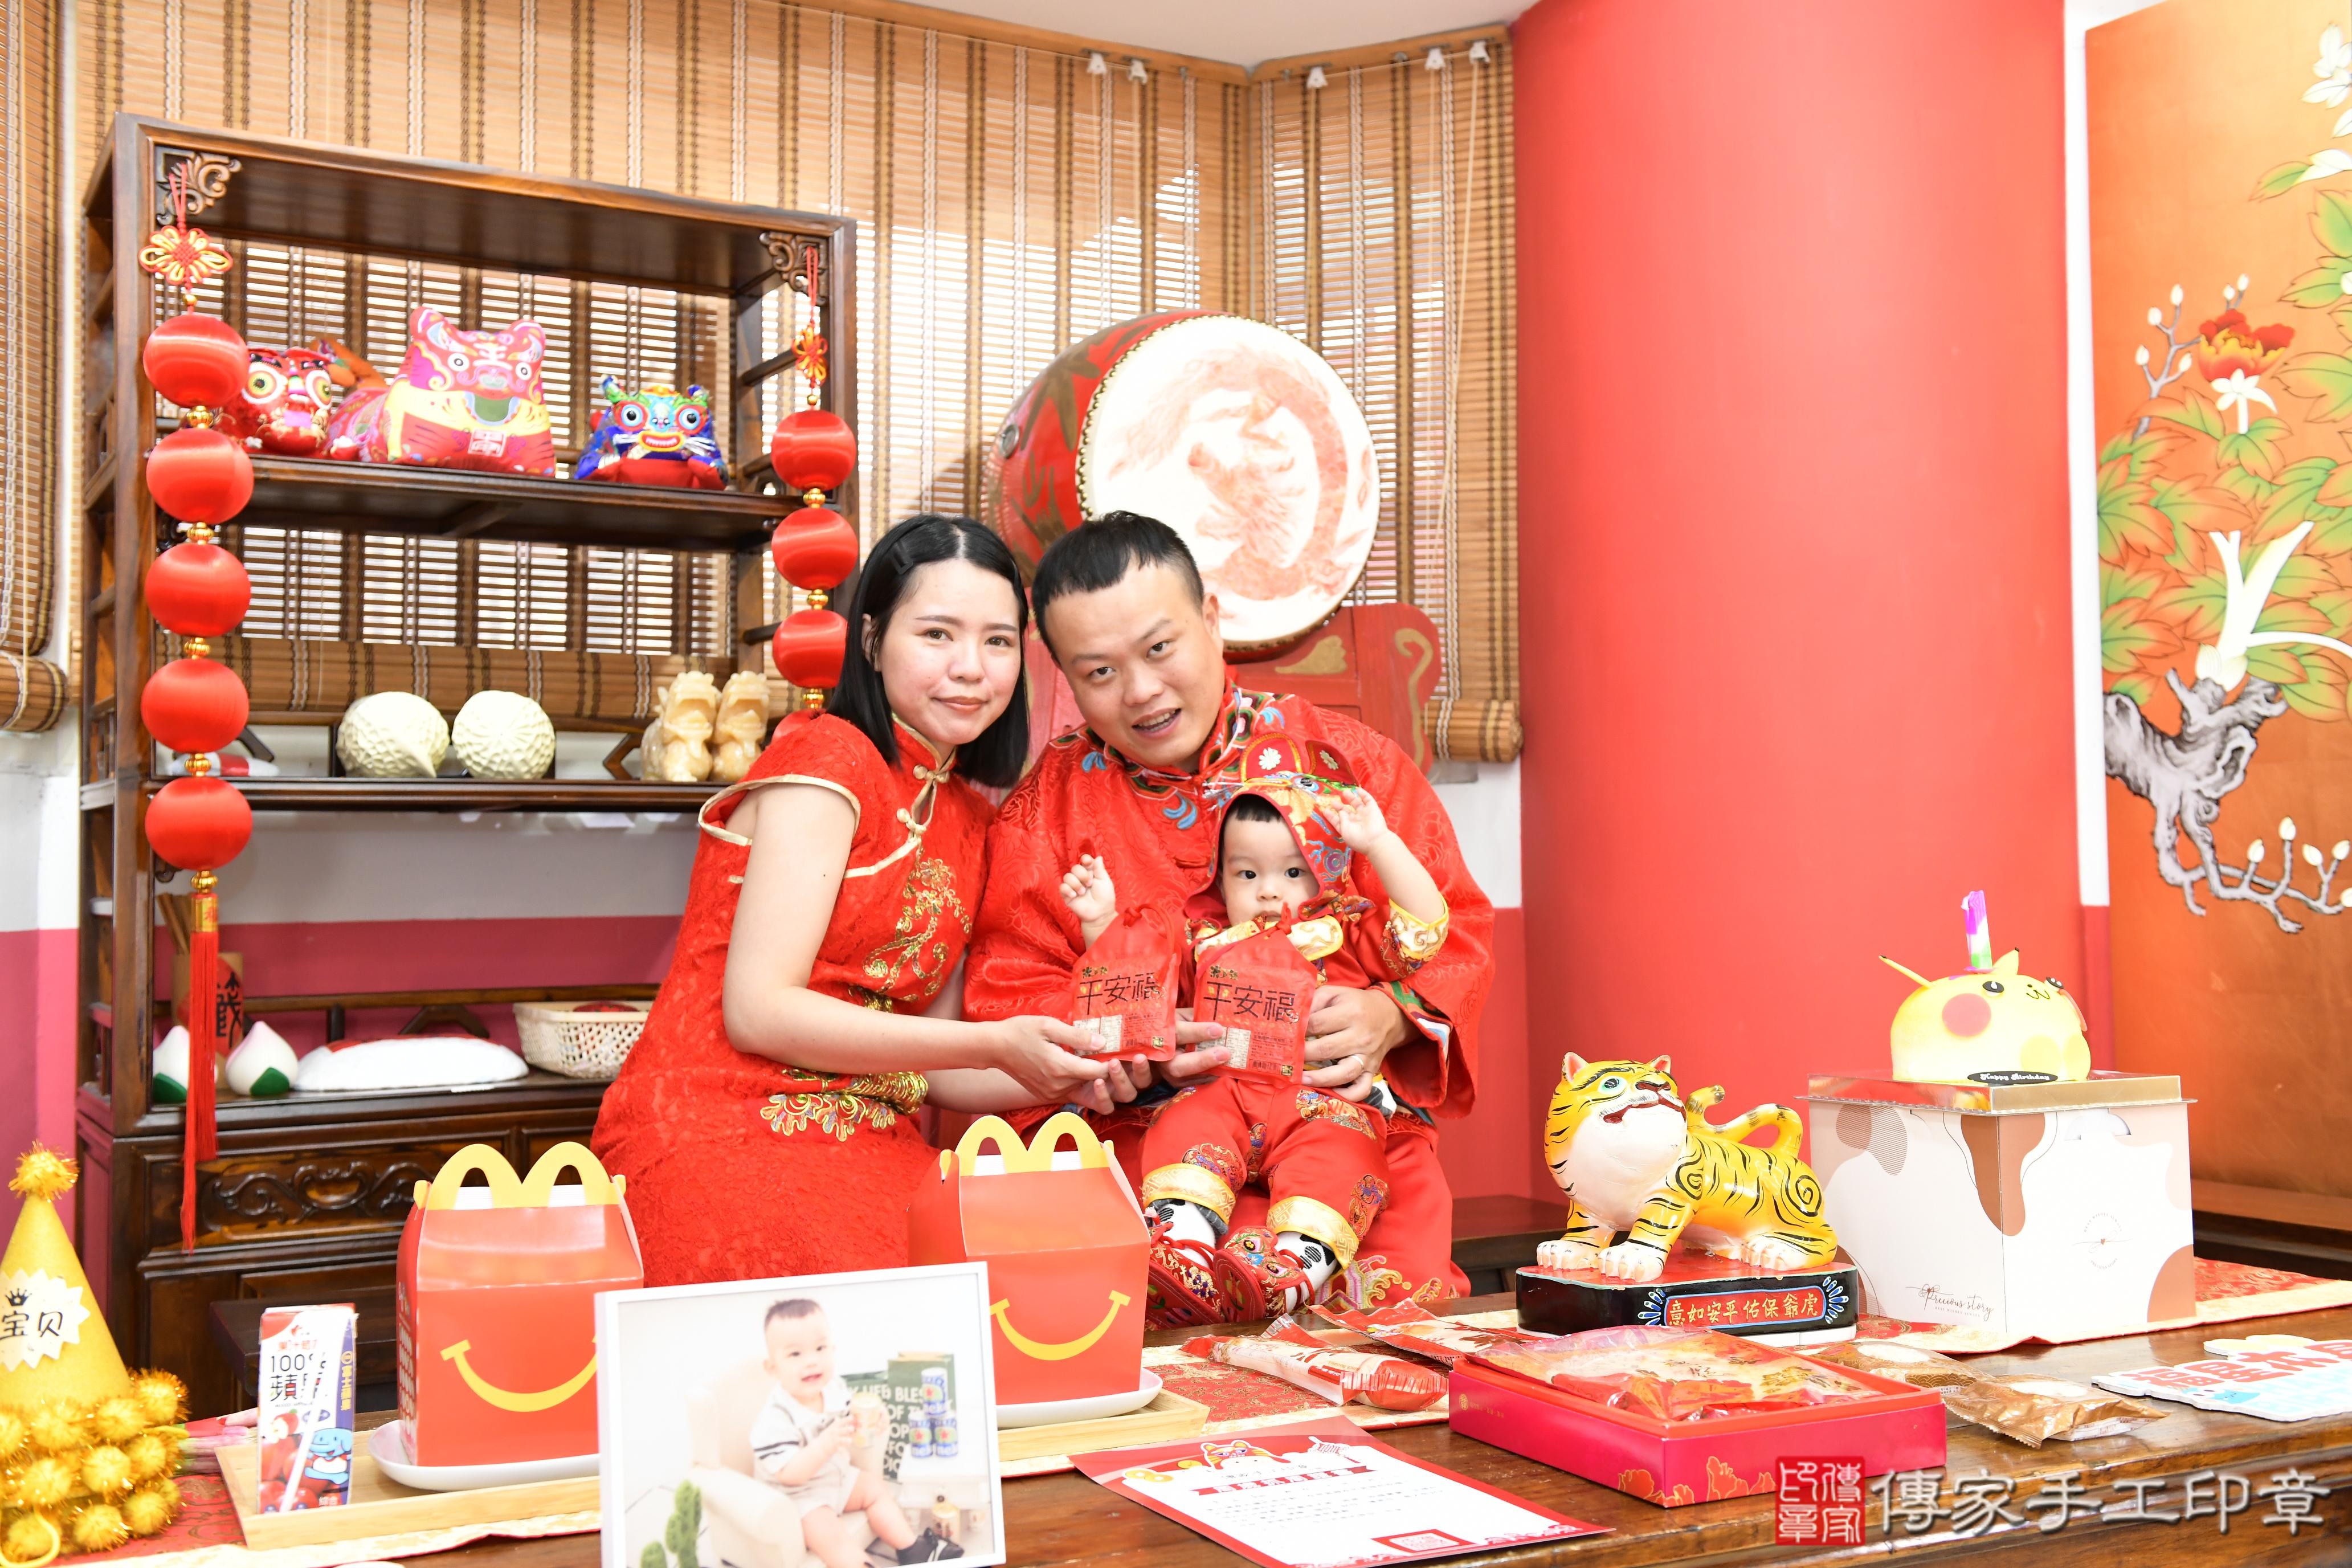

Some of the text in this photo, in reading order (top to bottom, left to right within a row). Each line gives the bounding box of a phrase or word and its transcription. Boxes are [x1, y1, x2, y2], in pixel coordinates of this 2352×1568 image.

[1204, 981, 1297, 1022] 平安福
[1921, 1283, 1994, 1321] Precious story
[0, 1310, 63, 1340] 宝贝
